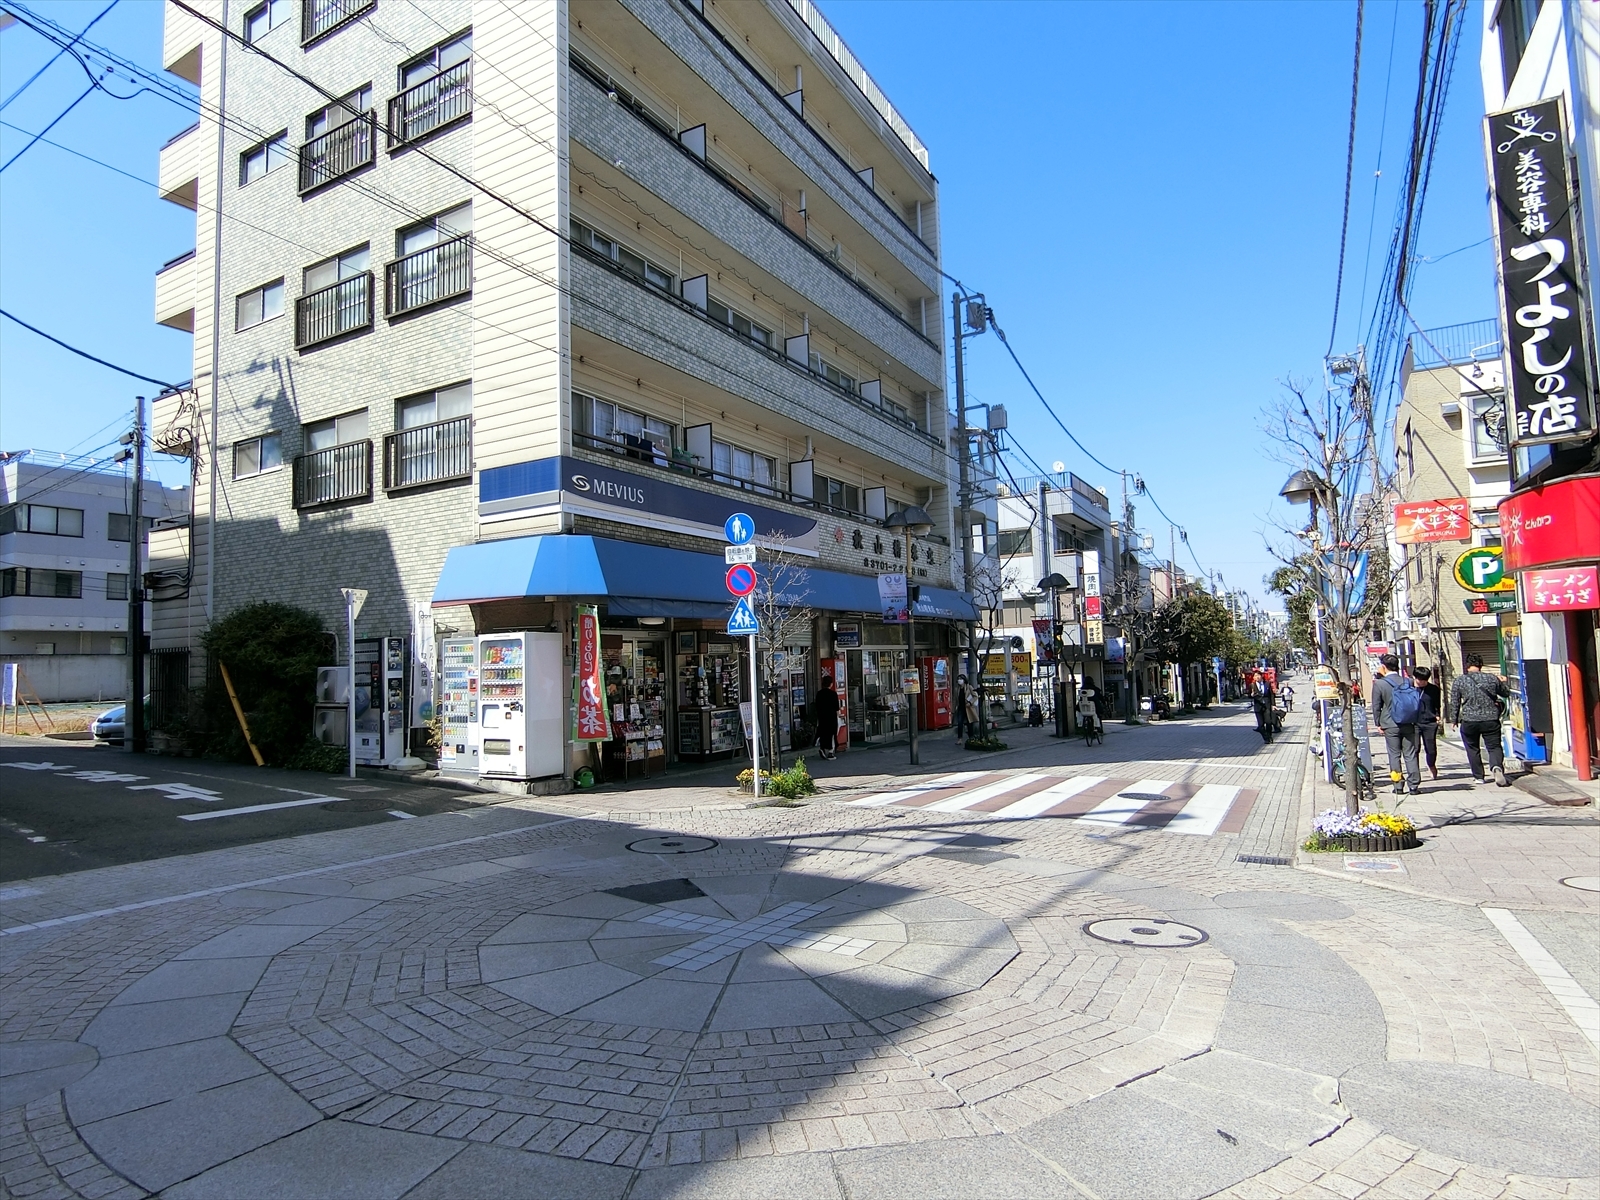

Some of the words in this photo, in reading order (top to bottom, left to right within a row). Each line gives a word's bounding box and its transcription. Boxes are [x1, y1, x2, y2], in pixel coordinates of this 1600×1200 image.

[1515, 149, 1550, 236] 美容専科
[1510, 238, 1577, 435] つよしの店
[1517, 412, 1529, 436] 2F
[593, 477, 645, 505] MEVIUS
[1525, 514, 1552, 530] とんかつ
[727, 547, 754, 555] 自転車を除く
[1472, 557, 1499, 585] P
[1531, 574, 1591, 590] ラーメン
[1534, 588, 1592, 606] ぎょうざ
[420, 652, 428, 687] 取扱店舗
